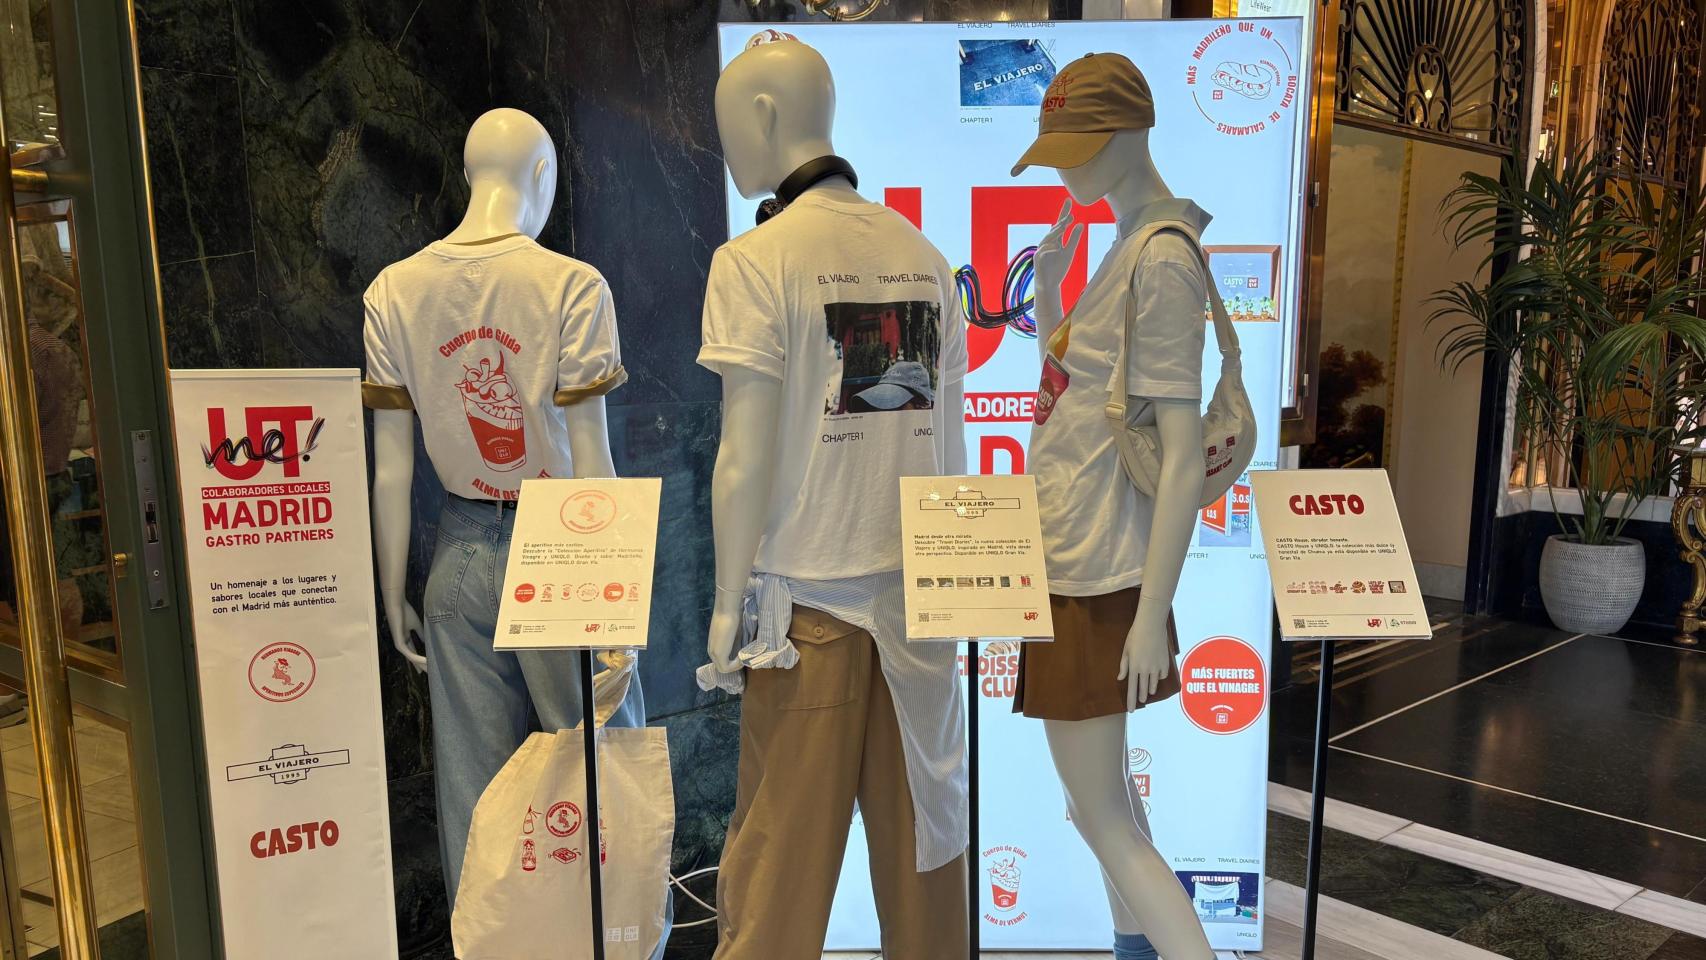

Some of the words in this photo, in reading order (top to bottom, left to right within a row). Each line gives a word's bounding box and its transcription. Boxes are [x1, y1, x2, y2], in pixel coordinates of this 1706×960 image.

[1192, 24, 1231, 60] MADRILEÑO
[1238, 22, 1254, 32] QUE
[1260, 27, 1273, 40] UN
[974, 80, 992, 91] EL
[993, 63, 1043, 84] VIAJERO
[1280, 75, 1297, 109] BOCATA
[1268, 111, 1280, 123] DE
[1216, 121, 1265, 135] CALAMARES
[818, 275, 829, 284] EL
[831, 274, 860, 284] VIAJERO
[877, 274, 912, 284] TRAVEL
[1224, 277, 1243, 285] CASTO
[438, 327, 477, 358] Cuerpo
[478, 326, 493, 339] de
[495, 329, 522, 355] Gilda
[207, 406, 313, 480] UT
[822, 432, 860, 443] CHAPTER
[202, 486, 285, 498] COLABORADORES
[288, 484, 330, 494] LOCALES
[472, 478, 500, 499] ALMA
[1289, 494, 1364, 516] CASTO
[202, 497, 332, 531] MADRID
[206, 533, 260, 548] GASTRO
[266, 529, 334, 544] PARTNERS
[211, 582, 222, 590] Un
[228, 579, 267, 589] homenaje
[283, 577, 293, 585] los
[298, 575, 327, 584] lugares
[332, 574, 337, 582] y
[211, 593, 243, 602] sabores
[248, 590, 277, 599] locales
[282, 589, 296, 597] que
[301, 585, 337, 595] conectan
[213, 606, 228, 614] con
[231, 604, 239, 612] el
[242, 601, 270, 611] Madrid
[273, 600, 290, 609] más
[293, 596, 337, 607] aunténtico.
[1191, 667, 1213, 679] MÁS
[1214, 668, 1255, 679] FUERTES
[1186, 682, 1206, 694] QUE
[1207, 683, 1217, 693] EL
[1219, 682, 1260, 693] VINAGRE
[275, 757, 319, 769] VIAJERO
[281, 772, 300, 780] 1995
[250, 820, 339, 859] CASTO
[983, 845, 1003, 857] Cuerpo
